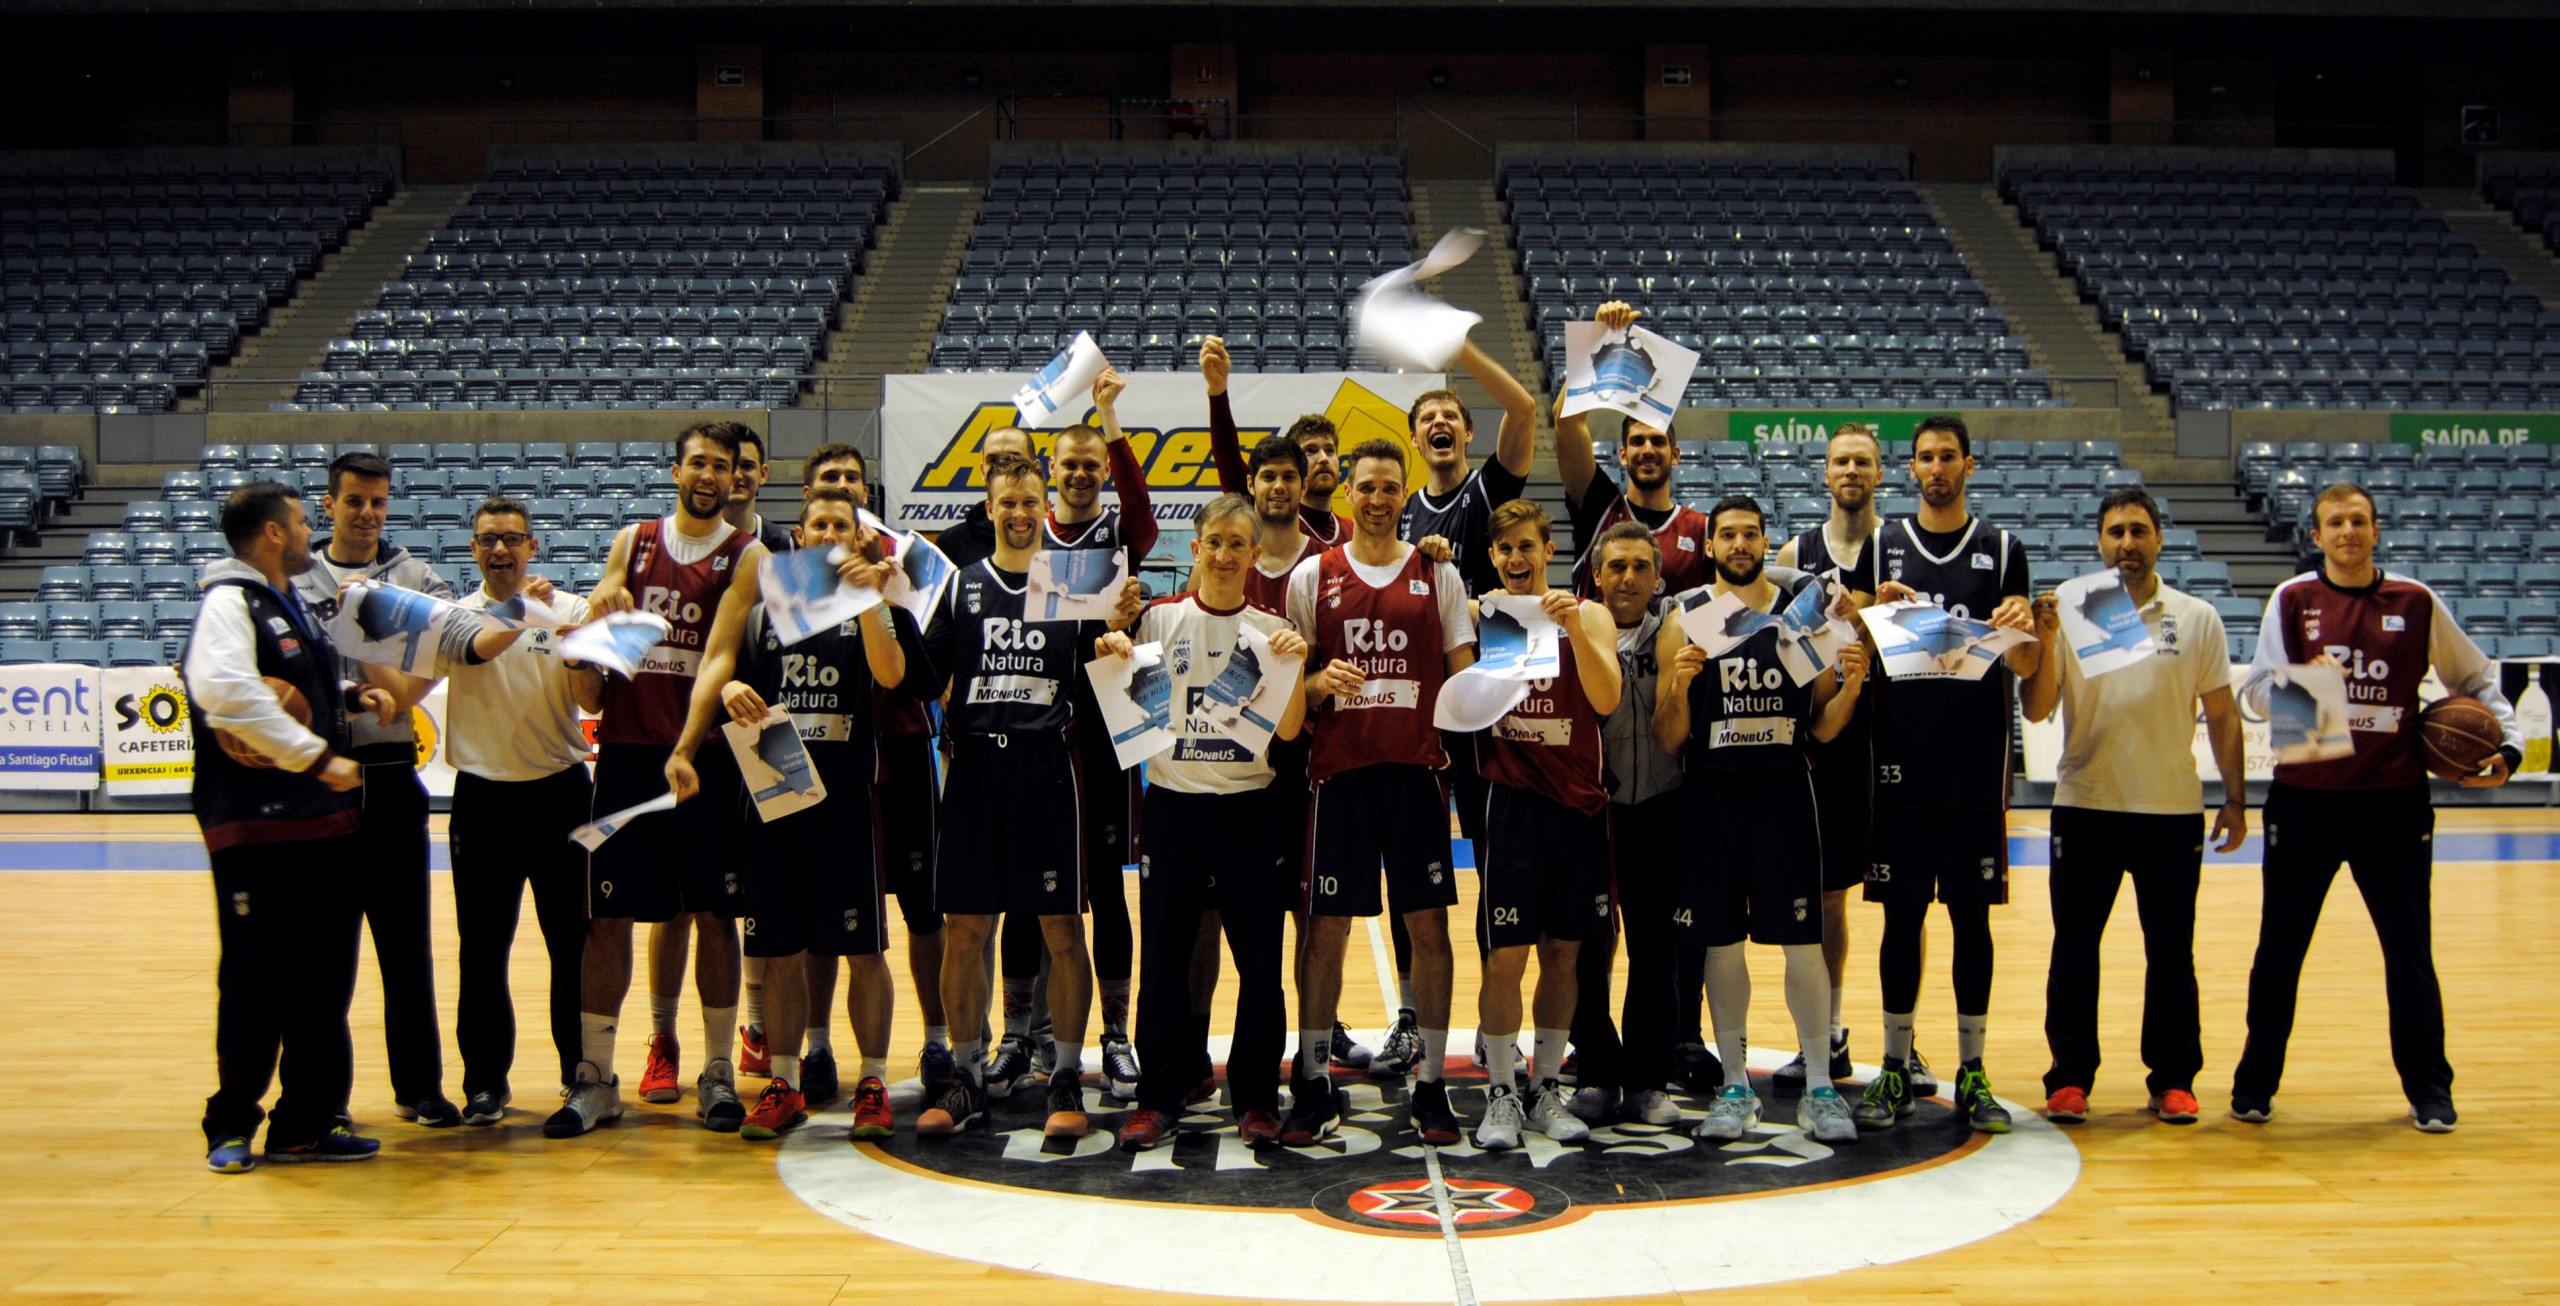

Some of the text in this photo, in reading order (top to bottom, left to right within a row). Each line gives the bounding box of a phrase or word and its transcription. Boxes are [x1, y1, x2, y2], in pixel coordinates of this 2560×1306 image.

[1754, 418, 1828, 444] SAÍDA
[2421, 424, 2491, 448] SAÍDA
[899, 504, 975, 521] TRANS
[641, 586, 702, 623] Rio
[663, 627, 698, 645] ura
[984, 617, 1046, 650] Rio
[1344, 618, 1408, 655] Rio
[781, 653, 839, 688] Rio
[982, 653, 1044, 672] Natura
[1719, 657, 1783, 693] Rio
[778, 691, 838, 708] Natura
[976, 688, 1033, 701] MONBUS
[2350, 685, 2388, 701] tura
[1516, 698, 1554, 713] tura
[1723, 695, 1783, 714] Natura
[798, 725, 827, 738] BUS
[1718, 729, 1774, 744] MONBUS
[9, 754, 57, 768] Santiago
[60, 753, 93, 766] Futsal
[1181, 748, 1236, 761] MONBUS
[117, 766, 166, 775] URXENCIAS
[1880, 765, 1902, 783] 33
[601, 881, 613, 899] 9
[1319, 876, 1338, 895] 10
[1494, 907, 1520, 926] 24
